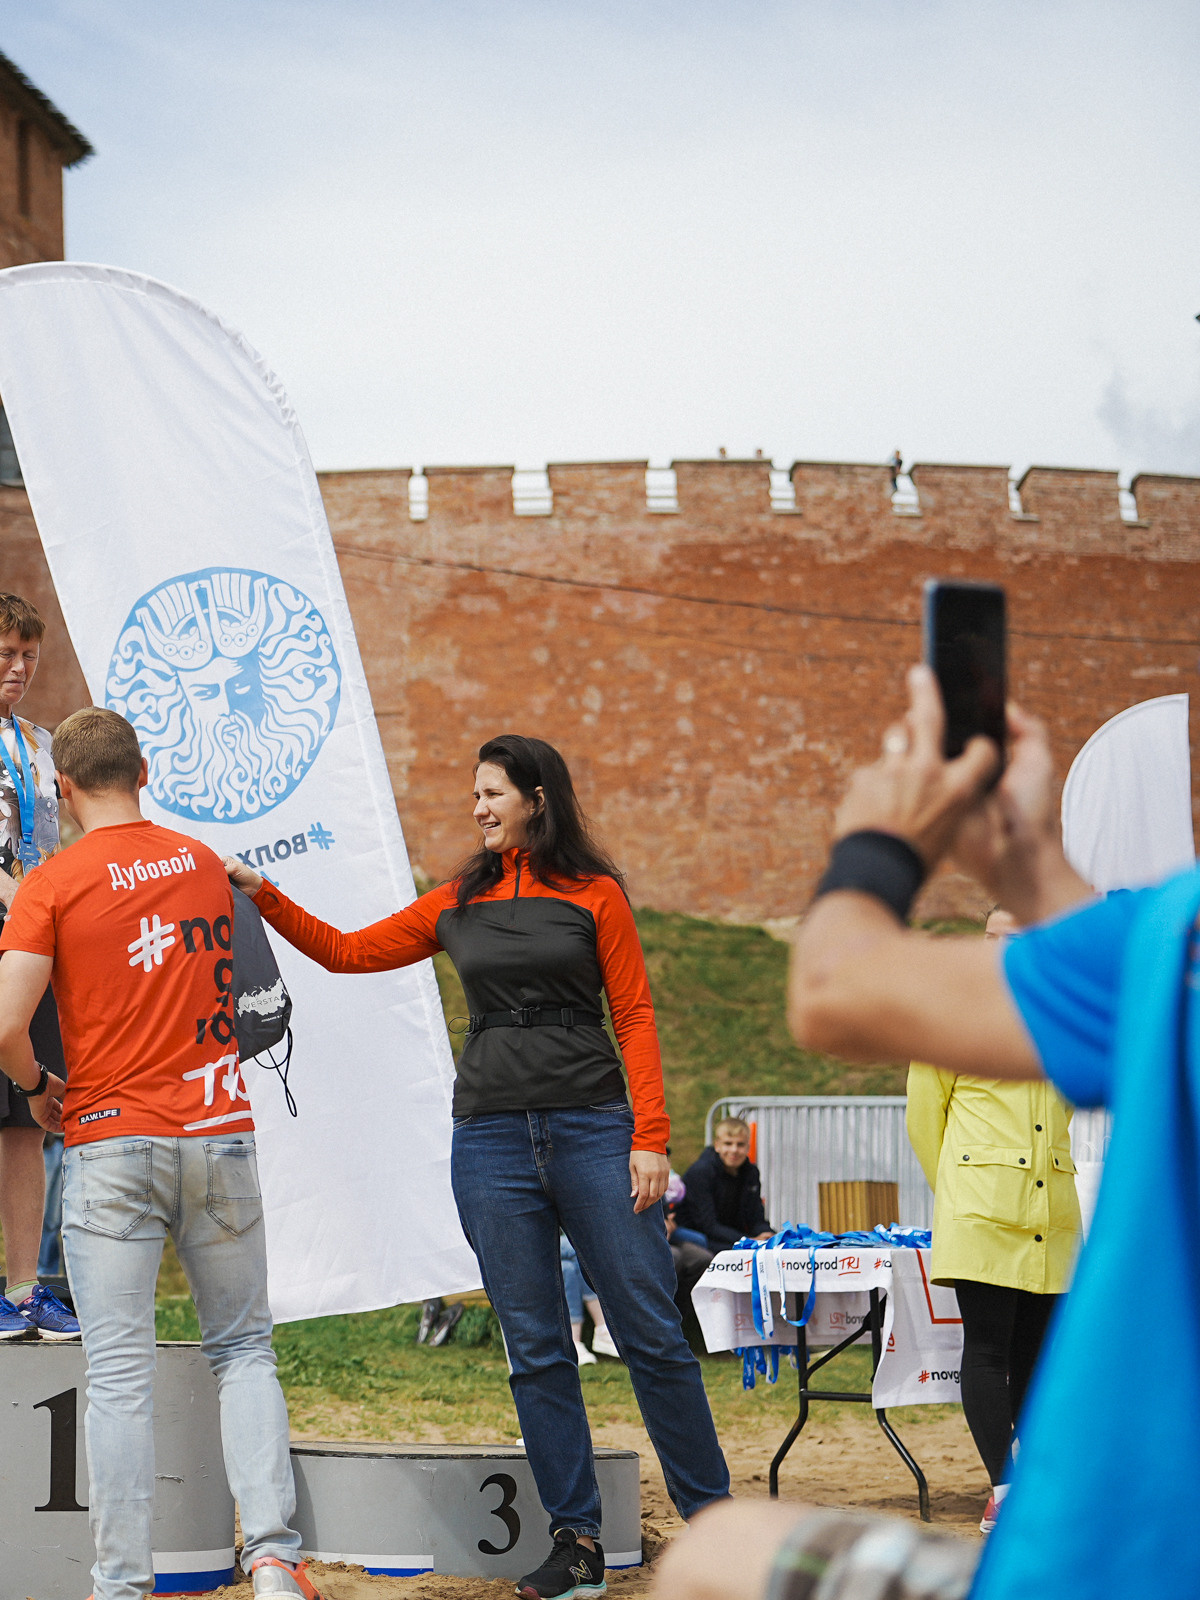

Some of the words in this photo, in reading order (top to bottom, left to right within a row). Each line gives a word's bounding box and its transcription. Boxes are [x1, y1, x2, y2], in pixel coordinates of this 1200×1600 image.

[107, 847, 197, 891] Дубовой
[127, 914, 232, 973] #no
[213, 957, 234, 1008] g
[243, 996, 280, 1010] VERSTA
[195, 1010, 237, 1046] ro
[918, 1369, 960, 1385] #novg
[33, 1387, 89, 1513] 1
[477, 1473, 521, 1555] 3
